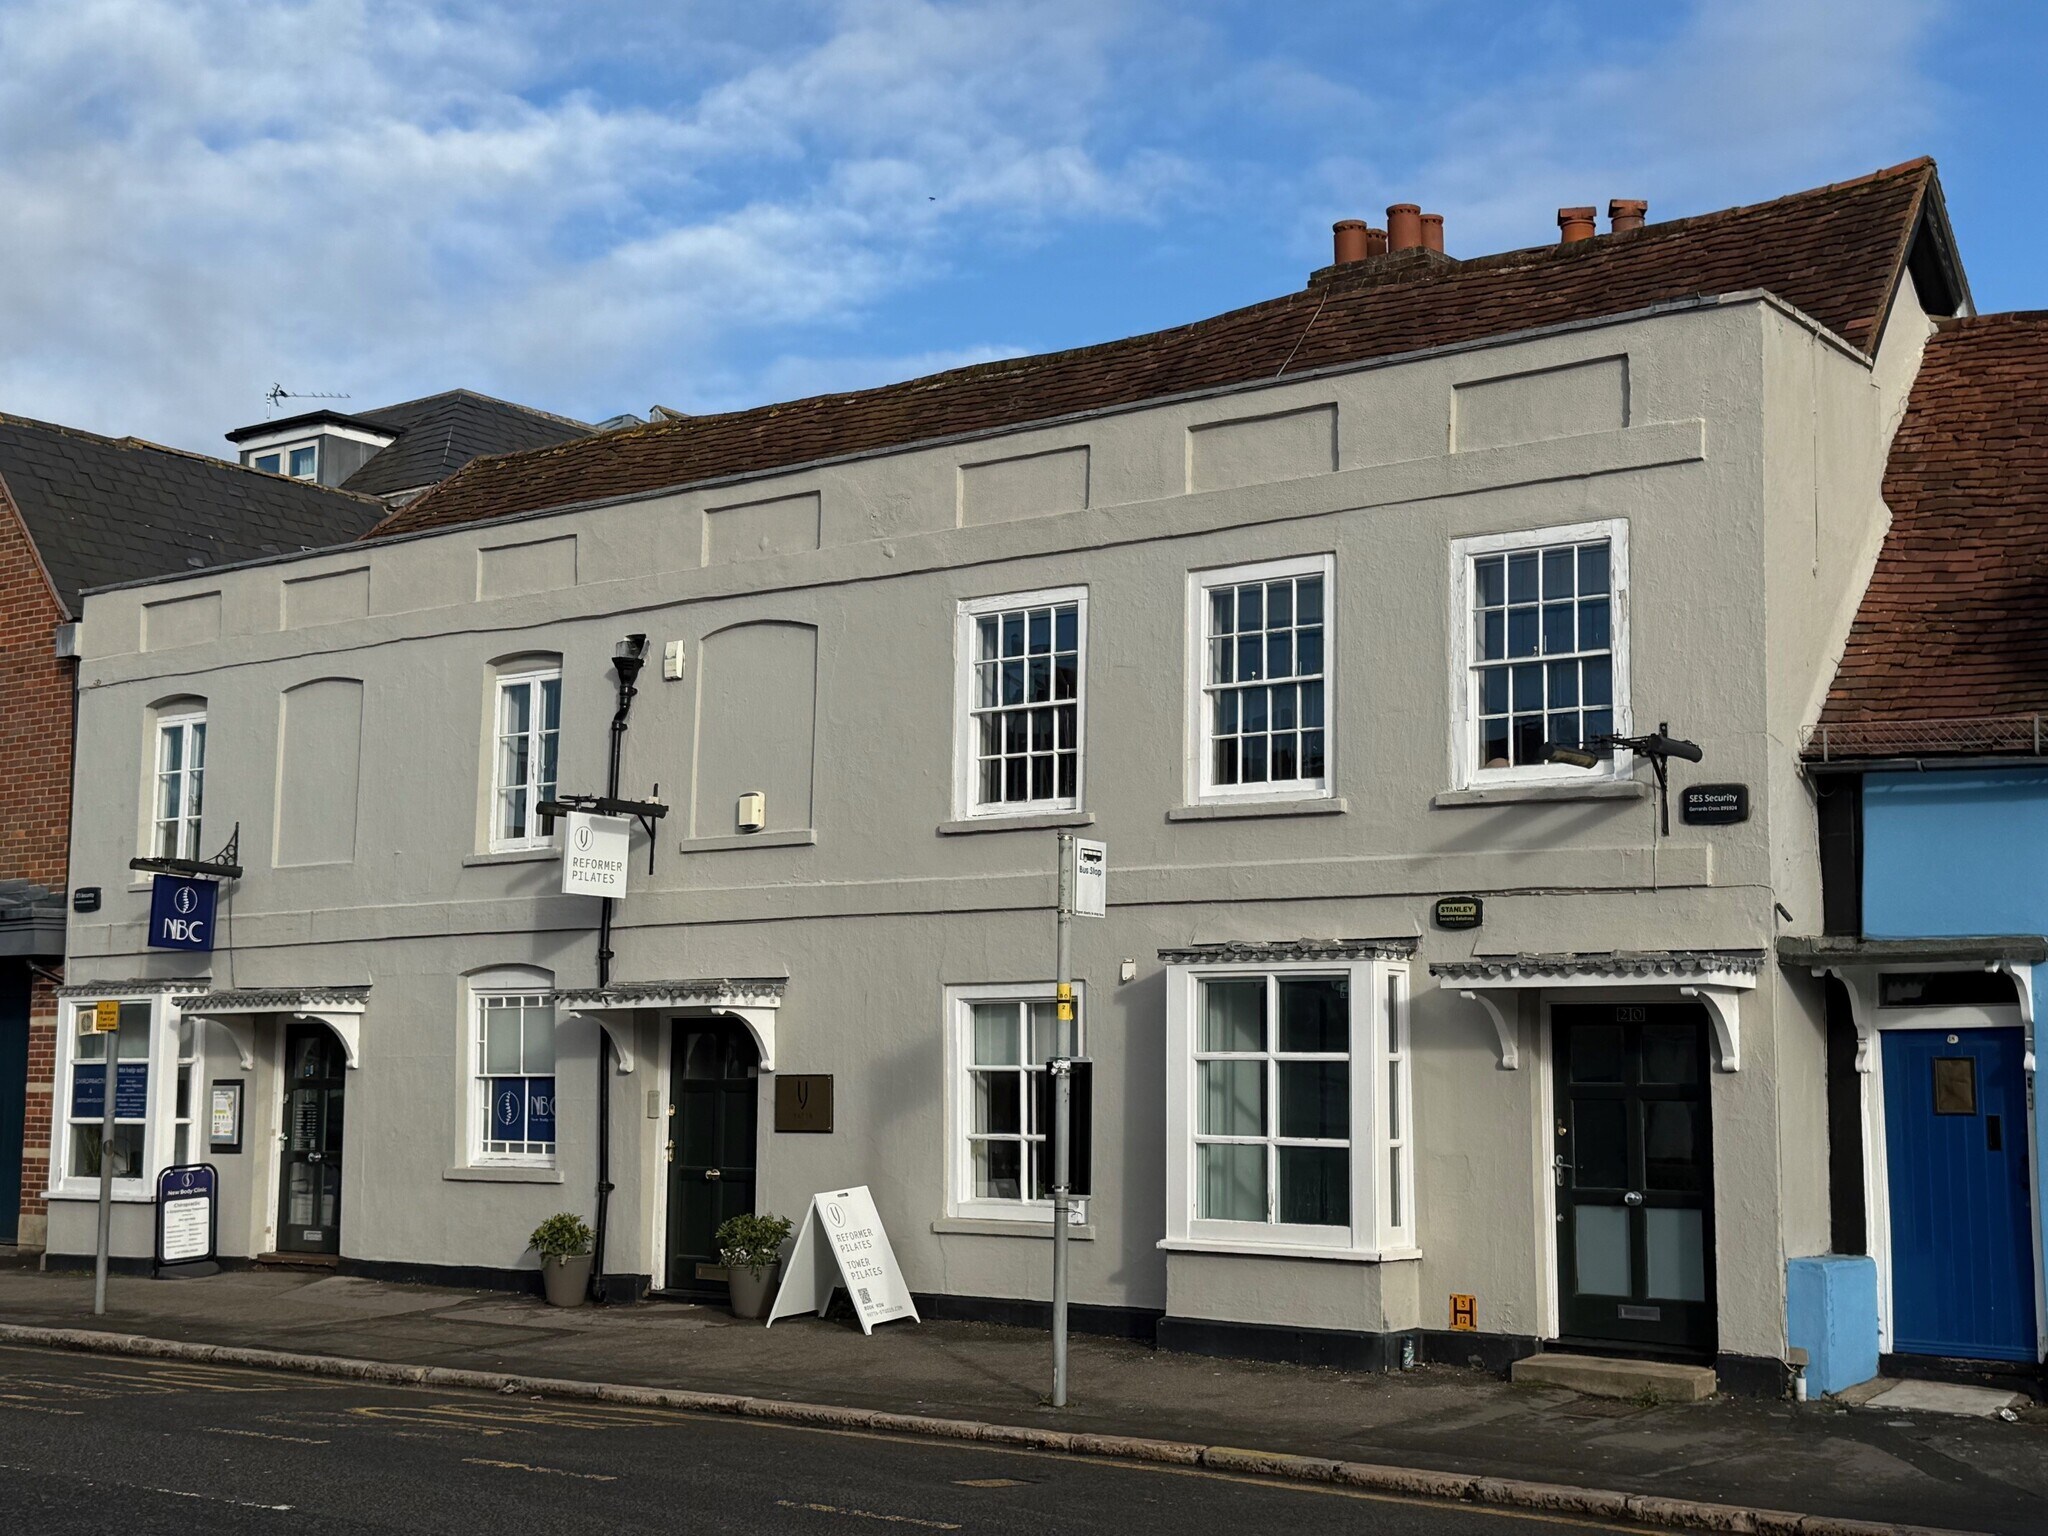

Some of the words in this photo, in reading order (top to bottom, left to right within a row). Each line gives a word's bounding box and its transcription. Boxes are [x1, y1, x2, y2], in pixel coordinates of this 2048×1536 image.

[1689, 794, 1703, 803] SES
[1705, 793, 1738, 803] Security
[572, 857, 623, 872] REFORMER
[572, 870, 615, 884] PILATES
[1079, 865, 1089, 874] Bus
[1090, 866, 1102, 878] Stop
[163, 917, 204, 943] NBC
[193, 1186, 208, 1194] Clinic
[836, 1228, 874, 1243] REFORMER
[840, 1239, 873, 1254] PILATES
[846, 1257, 871, 1270] TOWER
[850, 1266, 883, 1280] PILATES
[1460, 1300, 1466, 1308] 3
[1460, 1316, 1467, 1324] 12
